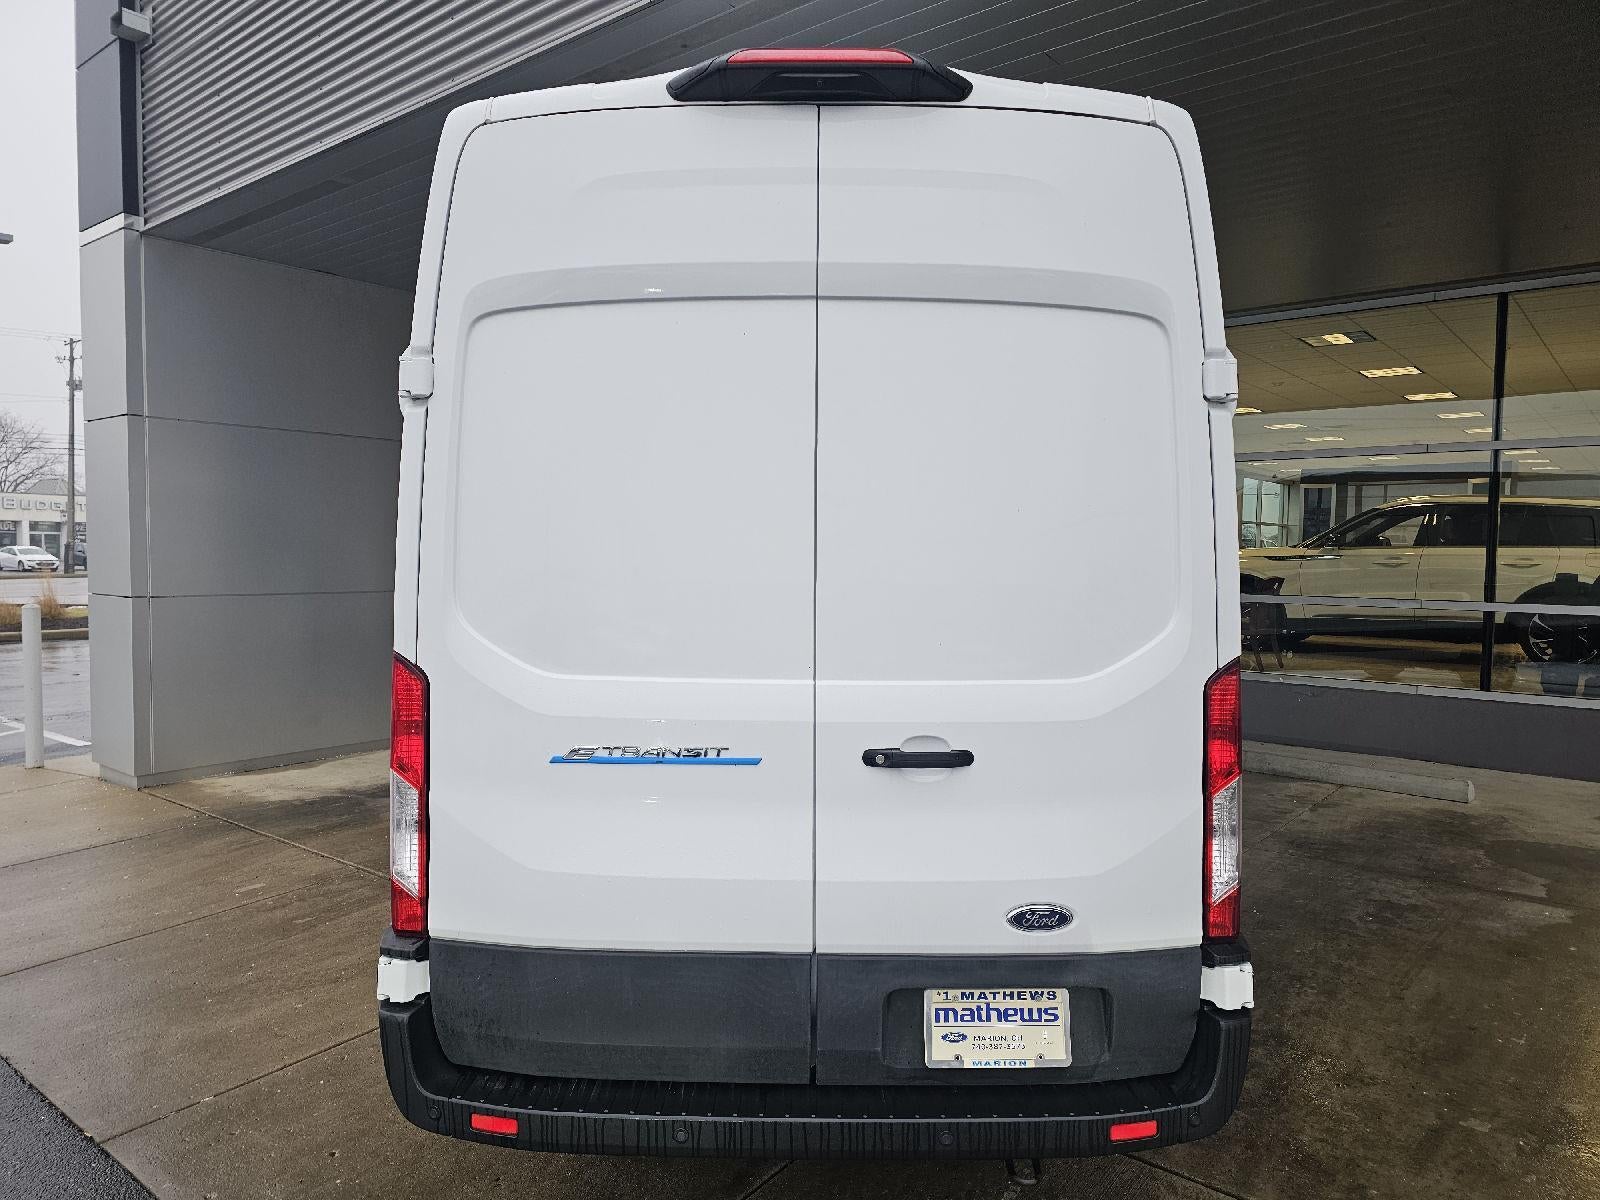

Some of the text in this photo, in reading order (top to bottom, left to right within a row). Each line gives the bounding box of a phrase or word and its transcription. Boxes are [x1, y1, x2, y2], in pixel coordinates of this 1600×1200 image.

[3, 496, 86, 512] BUDGT
[602, 746, 729, 757] TRANSIT
[1022, 911, 1060, 927] Ford
[960, 991, 1057, 1001] MATHEWS
[934, 1002, 1059, 1023] mathews
